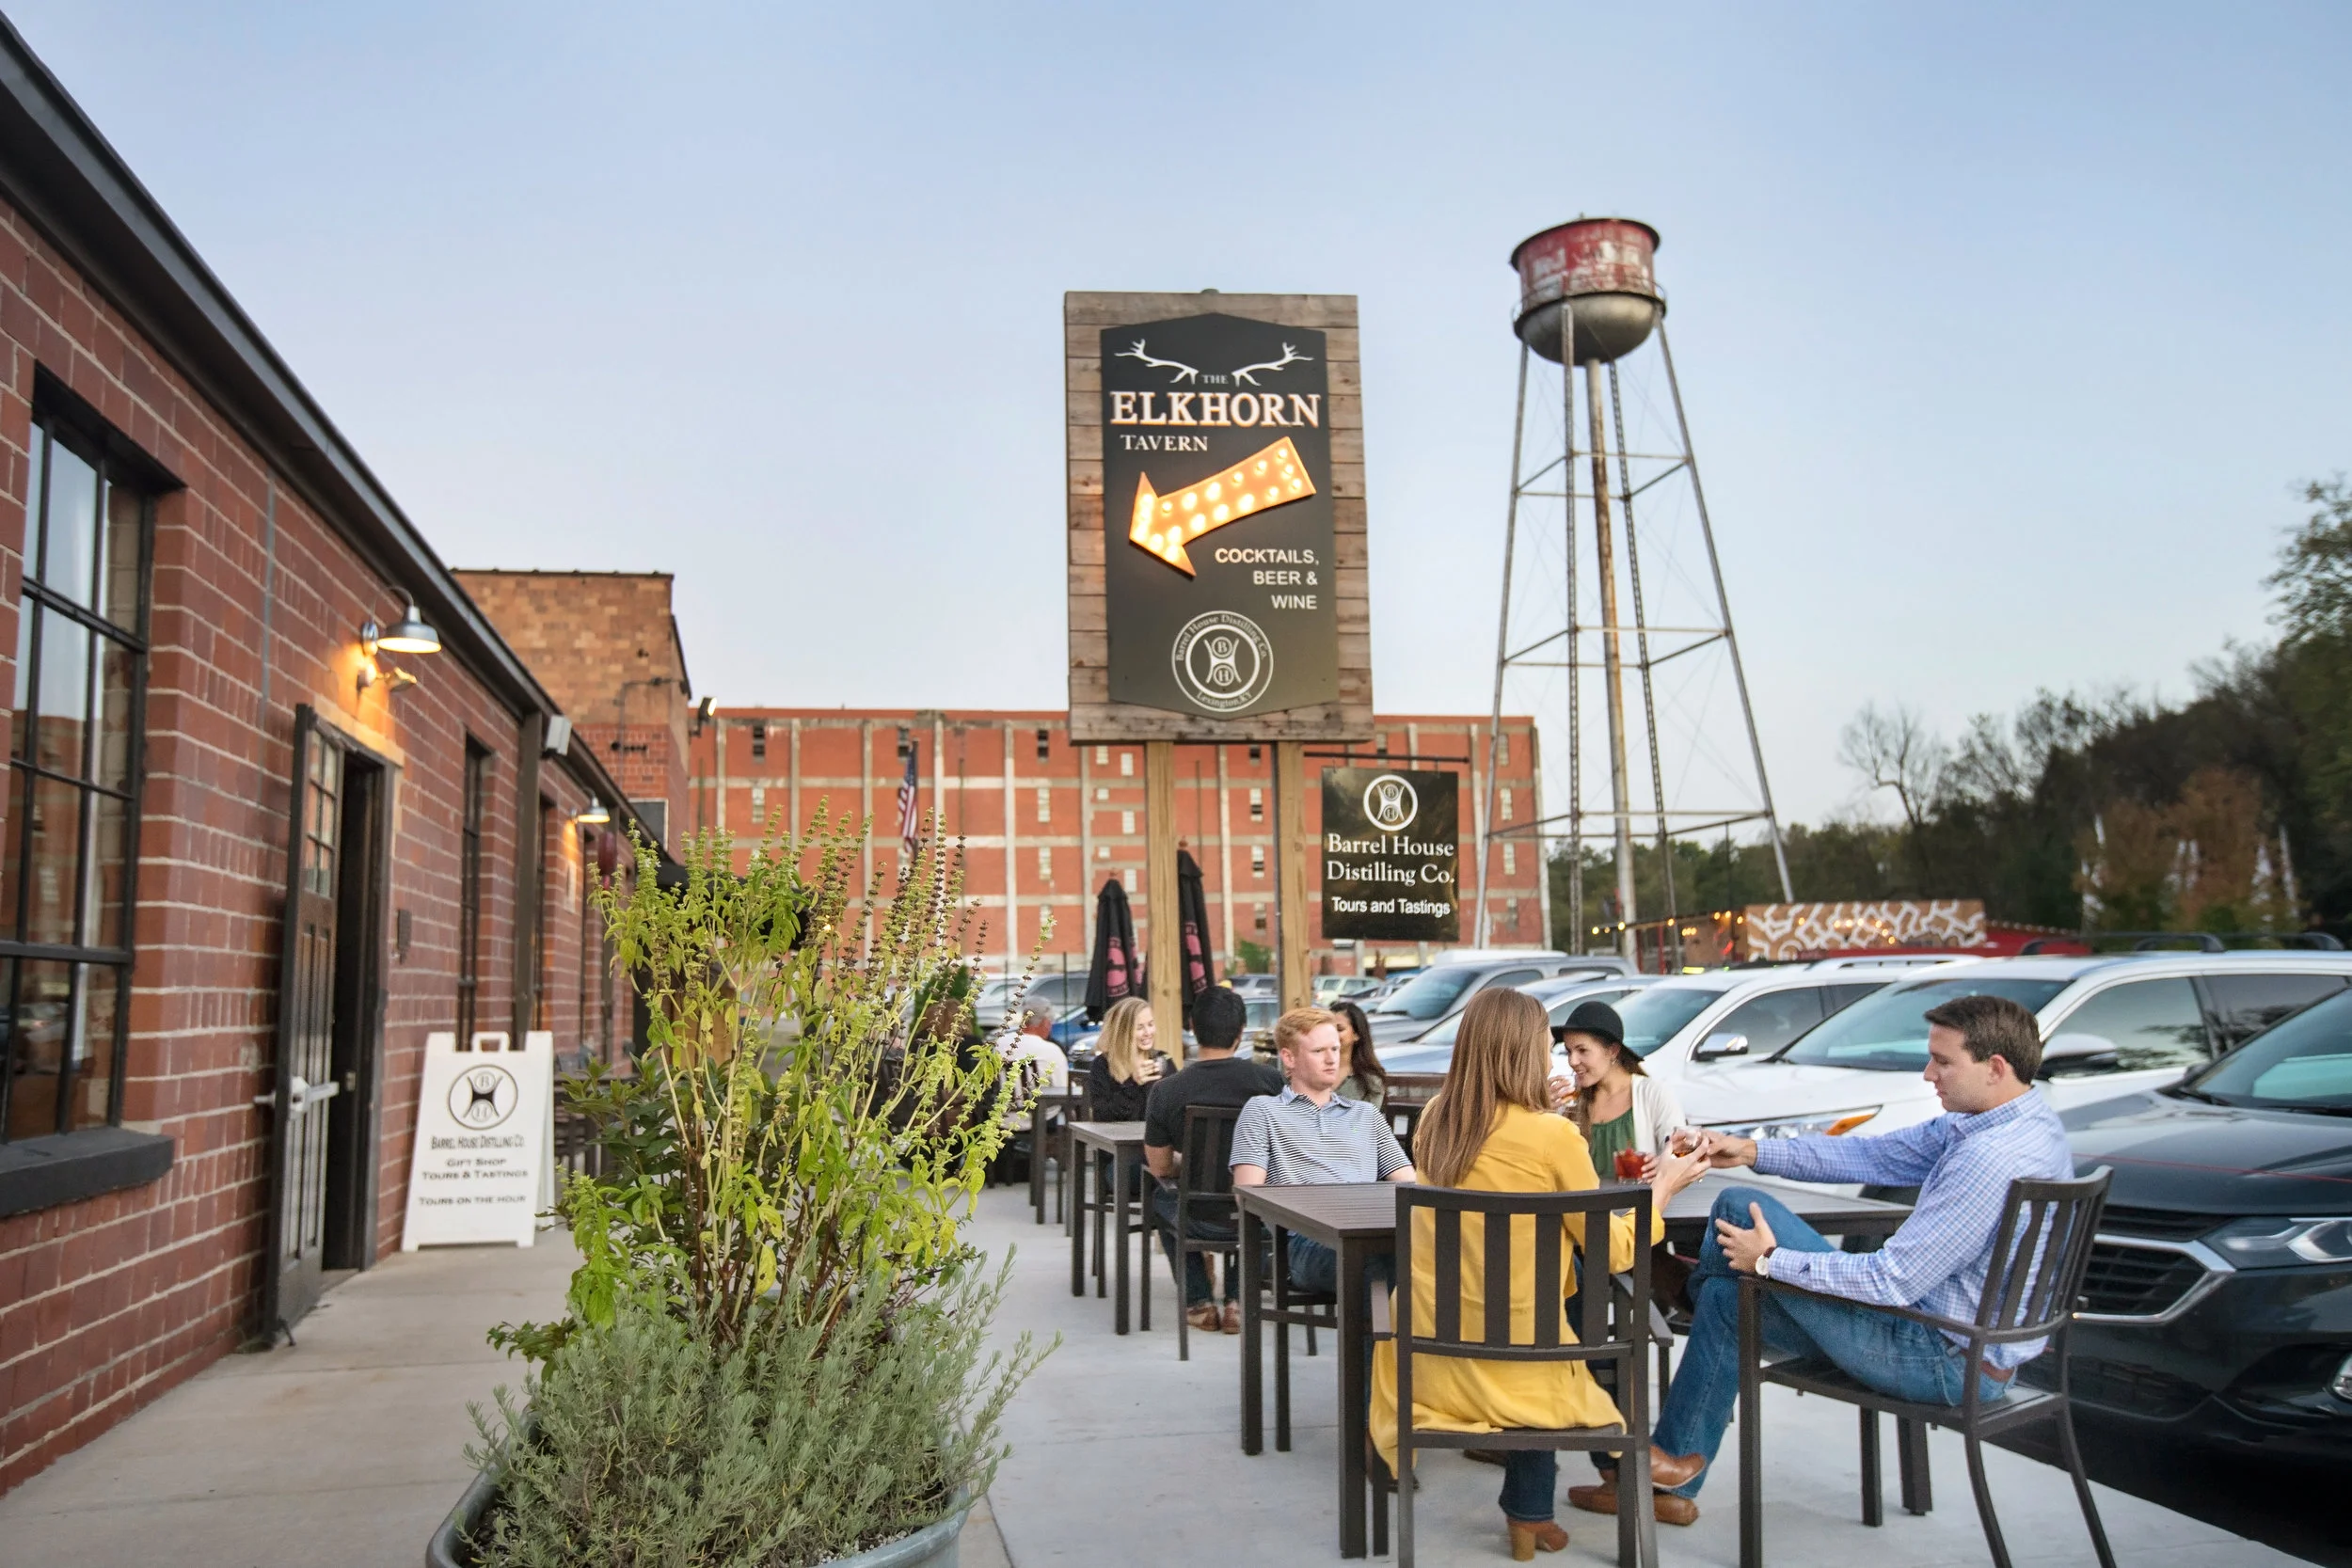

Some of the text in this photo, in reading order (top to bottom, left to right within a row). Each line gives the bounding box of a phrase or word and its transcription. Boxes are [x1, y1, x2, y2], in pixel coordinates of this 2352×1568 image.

[1203, 374, 1229, 385] THE
[1109, 390, 1321, 428] ELKHORN
[1120, 434, 1209, 452] TAVERN
[1215, 547, 1319, 565] COCKTAILS,
[1253, 570, 1318, 586] BEER &
[1271, 594, 1317, 610] WINE
[1175, 631, 1190, 661] Barrel
[1189, 616, 1219, 634] House
[1221, 614, 1261, 644] Distilling
[1217, 641, 1228, 654] B
[1217, 669, 1230, 682] H
[1328, 833, 1454, 857] Barrel House
[1327, 861, 1454, 887] Distilling Co.
[1331, 896, 1450, 918] Tours and Tastings
[422, 1171, 459, 1180] TOURS
[462, 1170, 470, 1180] &
[456, 1196, 471, 1205] ON
[474, 1196, 493, 1204] THE
[497, 1195, 526, 1203] HOUR
